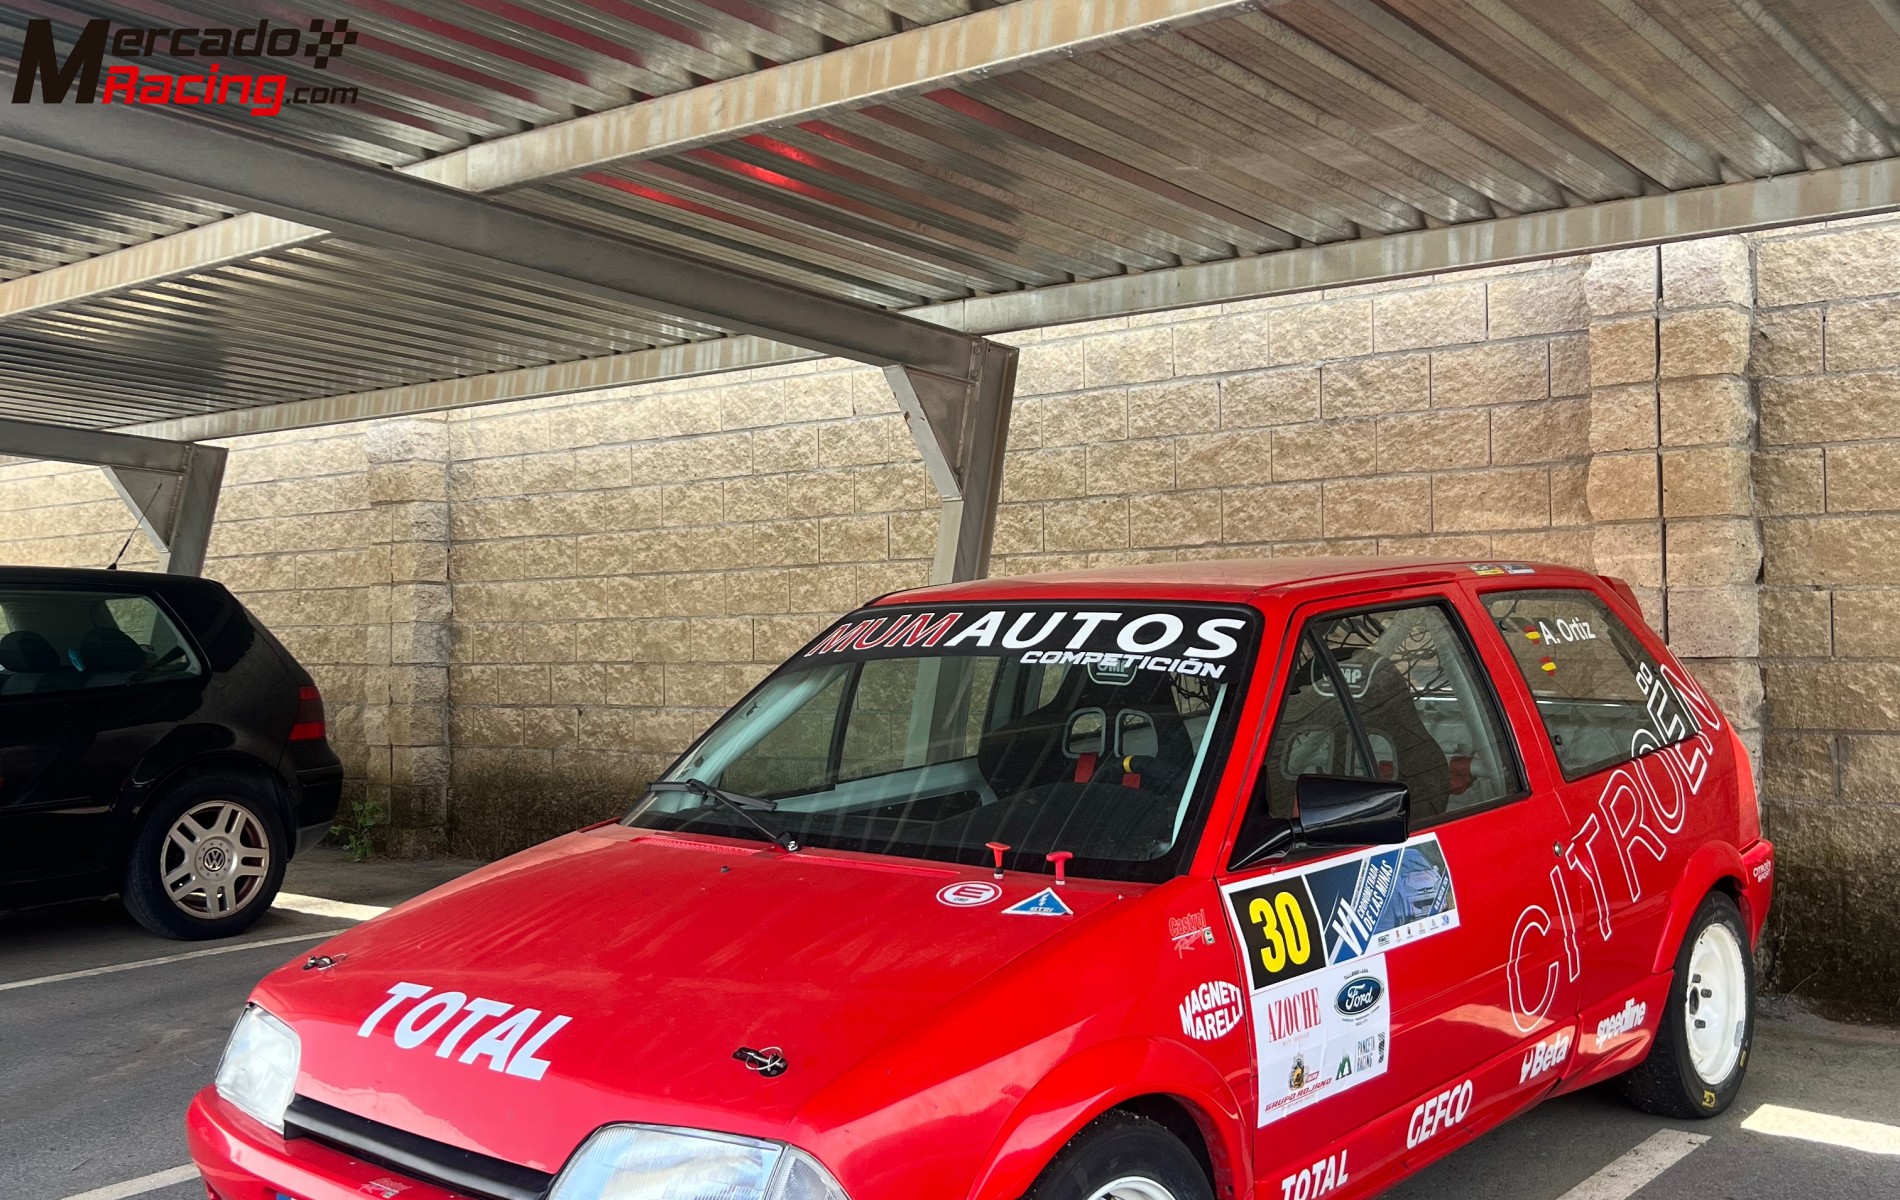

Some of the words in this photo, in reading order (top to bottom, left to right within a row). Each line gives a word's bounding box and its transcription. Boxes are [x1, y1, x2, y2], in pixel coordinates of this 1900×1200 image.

[1538, 620, 1561, 645] A.
[1556, 616, 1596, 643] Ortiz
[1019, 650, 1226, 680] COMPETICIÓN
[1506, 645, 1722, 1033] CITROËN
[1375, 859, 1393, 898] MINAS
[1168, 908, 1207, 938] Castrol
[1363, 909, 1376, 932] DE
[1368, 890, 1384, 918] LAS
[1248, 891, 1311, 974] 30
[1267, 986, 1322, 1044] AZOCHE
[1345, 983, 1374, 1010] Ford
[356, 981, 574, 1081] TOTAL
[1595, 997, 1647, 1050] speedline
[1264, 1092, 1297, 1112] GRUPO
[1406, 1078, 1474, 1150] GEFCO
[1281, 1148, 1349, 1200] TOTAL
